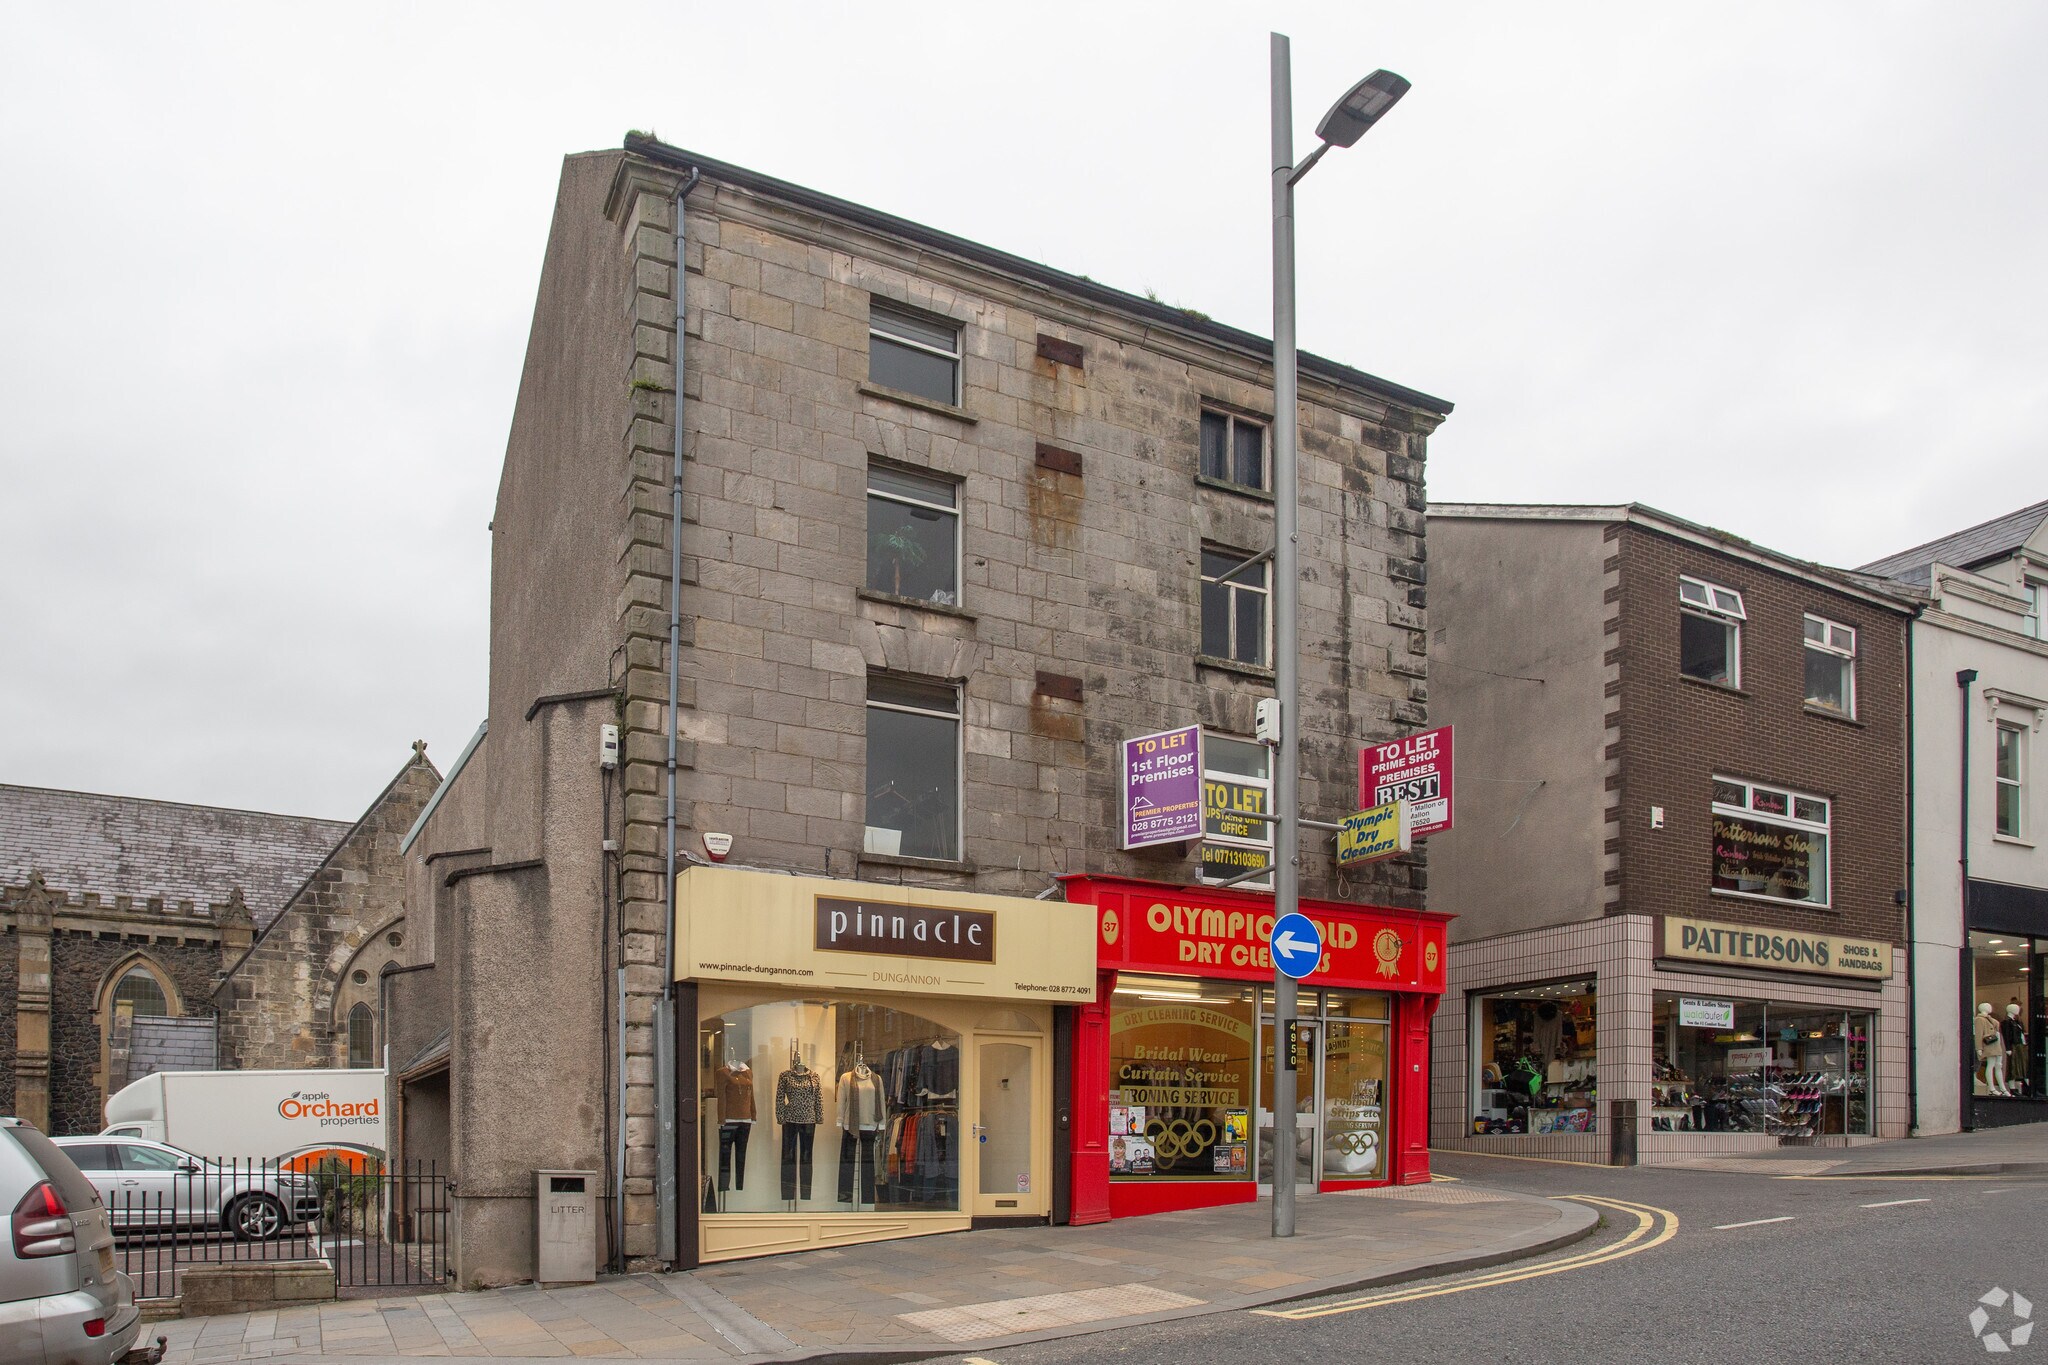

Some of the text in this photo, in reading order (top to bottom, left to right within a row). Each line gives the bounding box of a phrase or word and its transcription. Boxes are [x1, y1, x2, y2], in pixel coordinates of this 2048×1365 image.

[1136, 733, 1188, 755] TO LET
[1377, 732, 1438, 762] TO LET
[1131, 752, 1194, 773] 1st Floor
[1372, 748, 1440, 774] PRIME SHOP
[1131, 765, 1195, 786] Premises
[1379, 763, 1436, 785] PREMISES
[1205, 783, 1263, 814] TO LET
[1377, 775, 1437, 806] BEST
[1135, 800, 1199, 818] PREMIER PROPERTIES
[1415, 801, 1436, 812] Mallon
[1131, 813, 1198, 832] 028 8775 2121
[1220, 821, 1248, 836] OFFICE
[1343, 807, 1393, 831] Olympic
[1356, 830, 1380, 844] Dry
[1712, 820, 1781, 848] Pattersons
[1202, 847, 1266, 868] Tel 07713103690
[1341, 839, 1395, 861] Cleaners
[1716, 844, 1749, 860] Rainbow
[830, 905, 983, 946] pinnacle
[1104, 922, 1117, 932] 37
[1147, 903, 1358, 950] OLYMPIC OLD
[1682, 925, 1878, 967] PATTERSONS SHOES &
[1179, 939, 1331, 973] DRY CLES
[1426, 952, 1436, 961] 37
[1838, 958, 1882, 971] HANDBAGS
[699, 962, 814, 977] www.pinnacle-dungannon.com
[872, 971, 941, 986] DUNGANNON
[1014, 982, 1091, 995] Telephone: 028 8772 4091
[1123, 1009, 1239, 1033] DRY CLEANING SERVICE
[1133, 1045, 1228, 1063] Bridal Wear
[1326, 1040, 1350, 1052] LAUND
[1119, 1064, 1240, 1083] Curtain Service
[301, 1091, 330, 1101] apple
[1124, 1088, 1180, 1104] IRONING
[1184, 1089, 1236, 1105] SERVICE
[281, 1098, 379, 1118] Orchard
[1330, 1107, 1378, 1119] Strips etc
[320, 1115, 380, 1127] properties
[551, 1205, 585, 1214] LITTER
